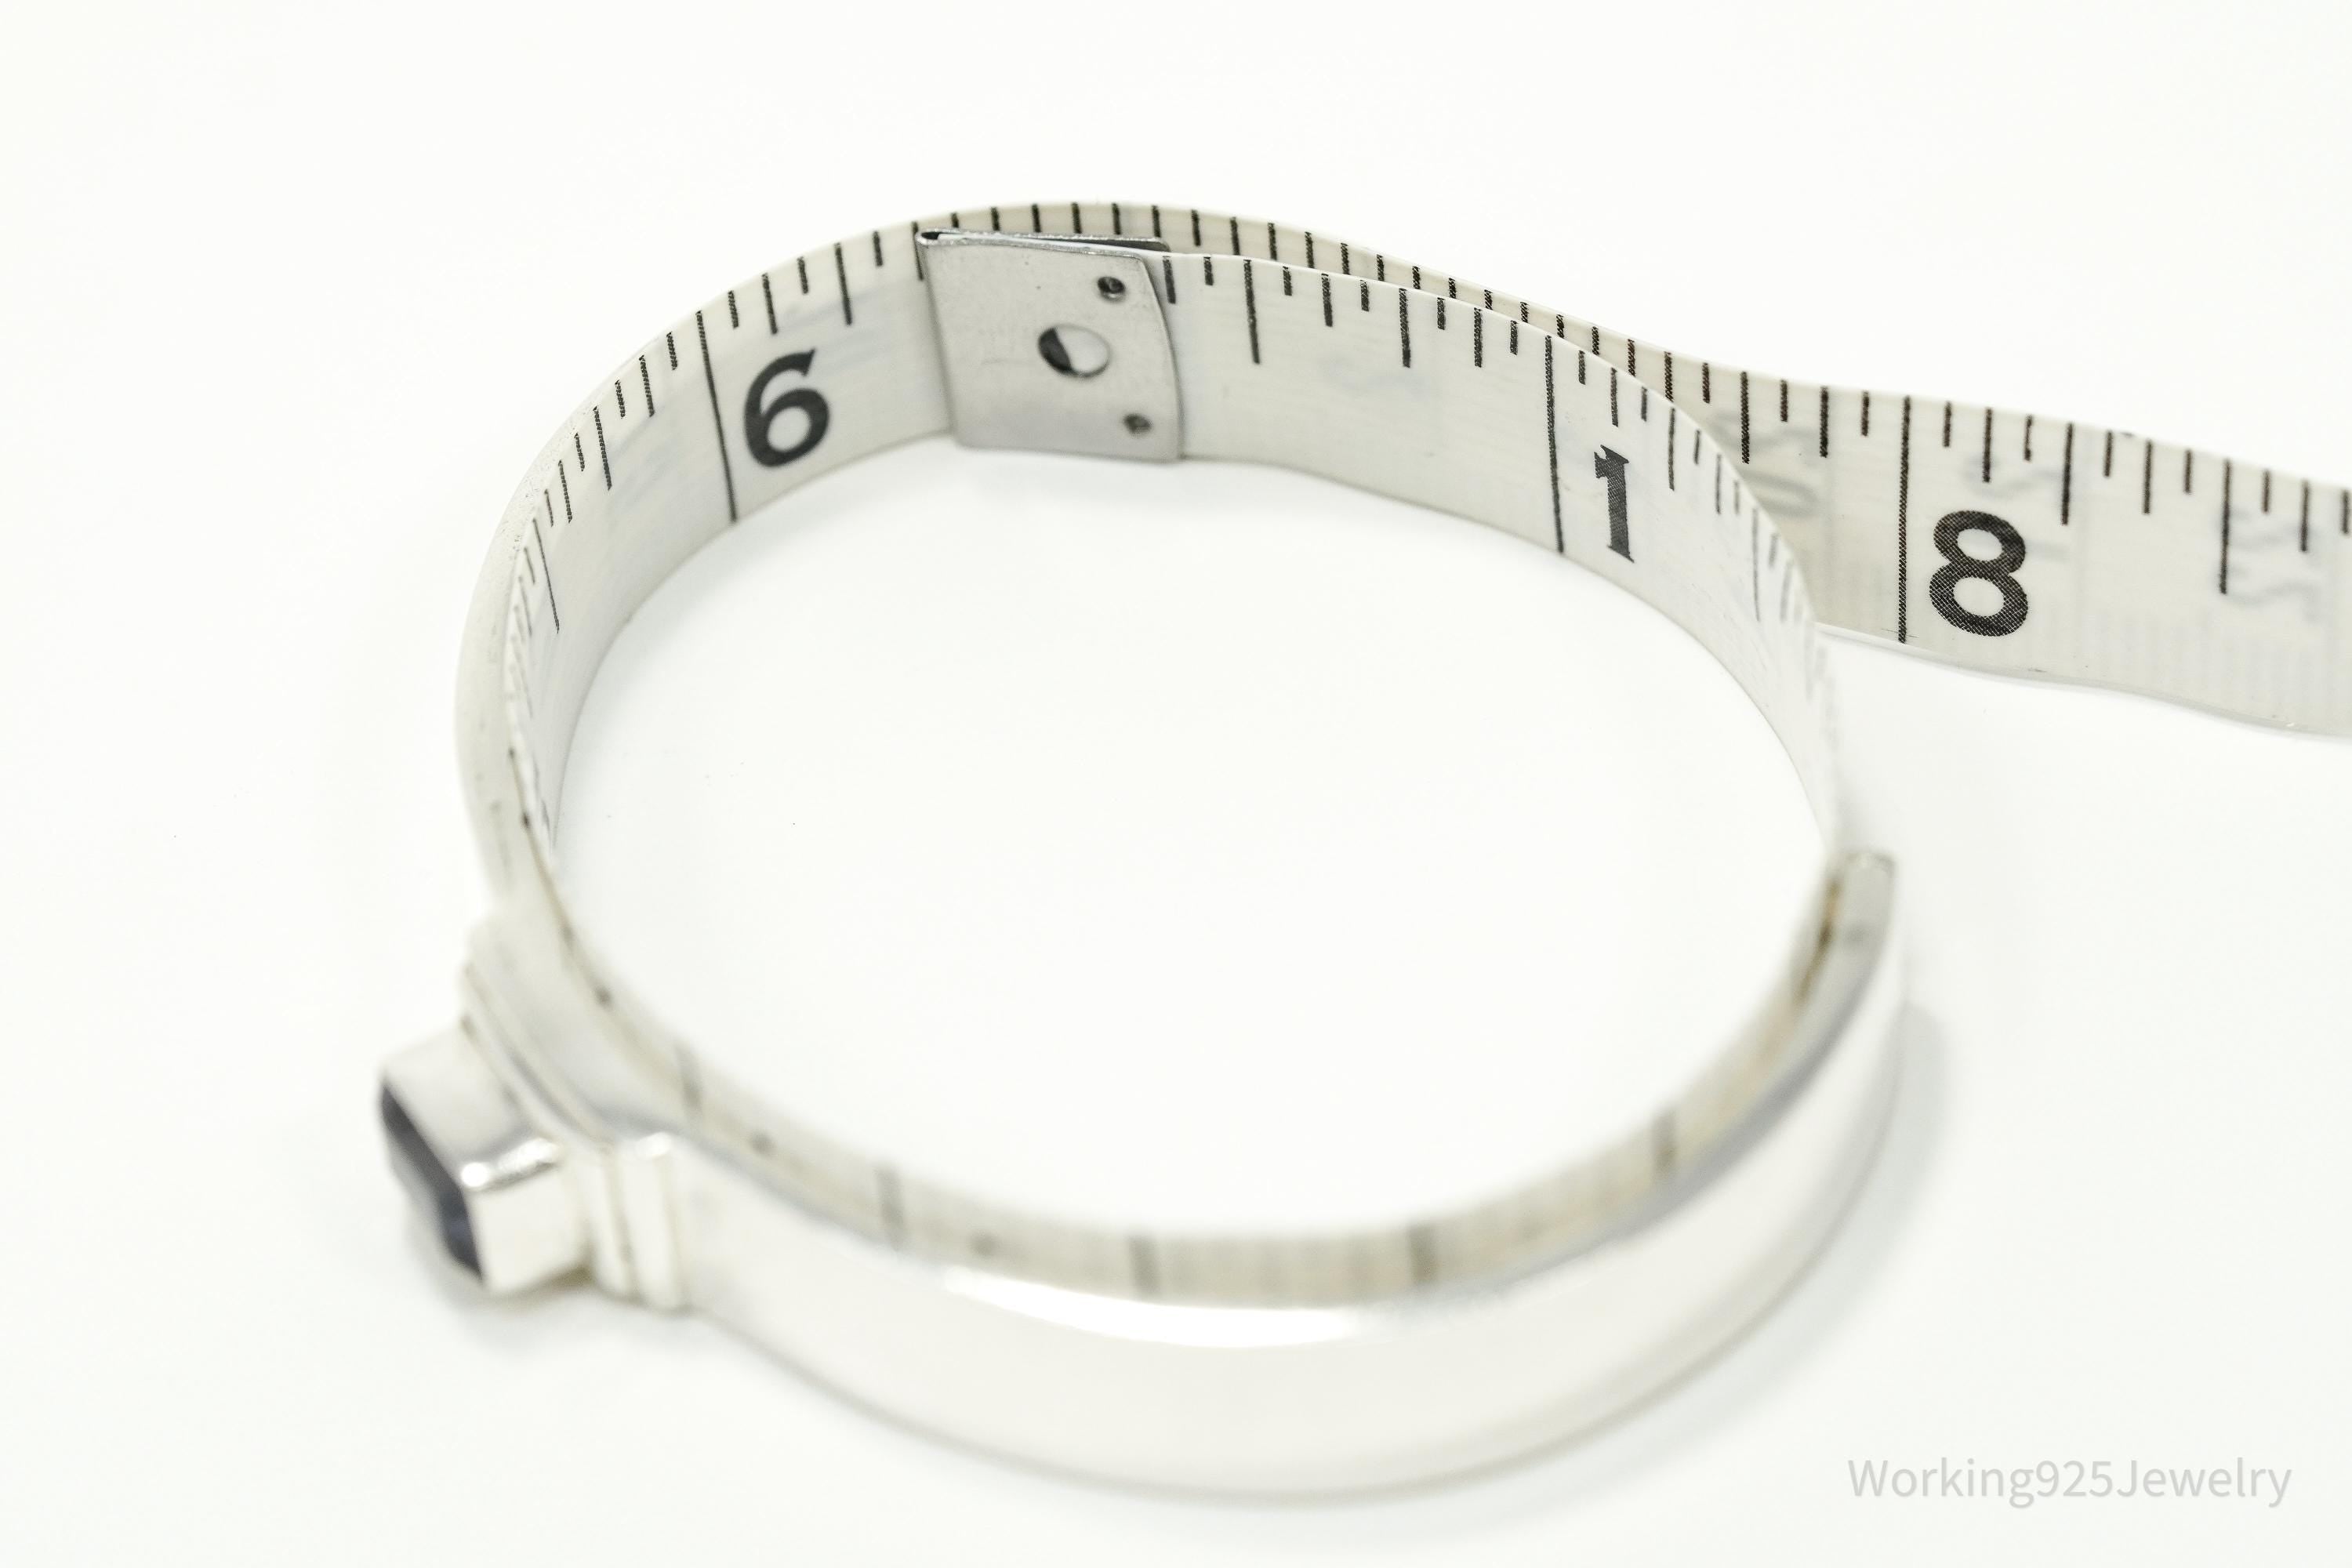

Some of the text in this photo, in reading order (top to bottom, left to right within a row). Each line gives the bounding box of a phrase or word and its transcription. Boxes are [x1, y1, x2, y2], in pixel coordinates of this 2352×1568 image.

[743, 349, 830, 468] 6
[1593, 444, 1635, 563] 1
[1929, 510, 2029, 637] 8
